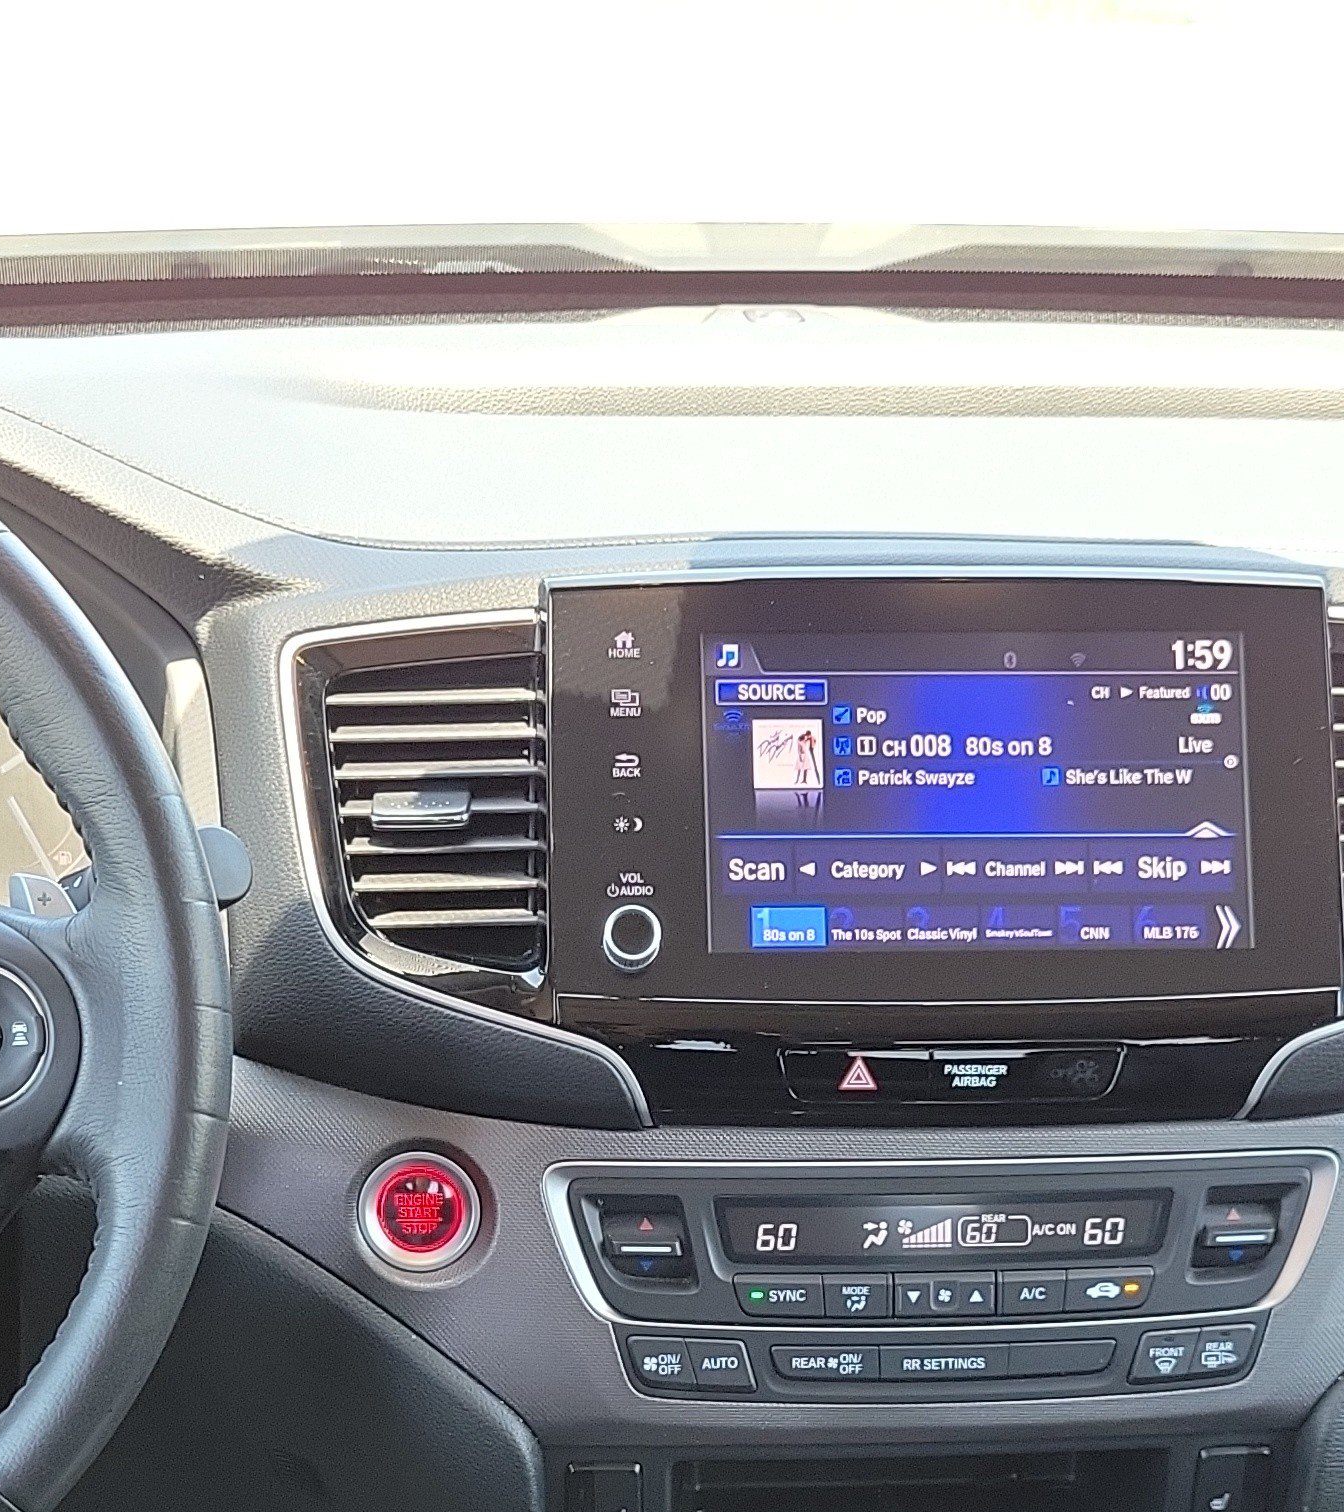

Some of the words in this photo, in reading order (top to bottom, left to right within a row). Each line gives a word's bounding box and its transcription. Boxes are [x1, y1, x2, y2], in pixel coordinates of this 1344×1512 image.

[608, 648, 641, 659] HOME
[1171, 639, 1233, 670] 1:59
[737, 683, 805, 701] SOURCE
[1091, 686, 1110, 699] CH
[1139, 686, 1191, 699] Featured
[610, 707, 641, 717] MENU
[856, 707, 887, 724] Pop
[882, 740, 906, 756] CH
[910, 735, 952, 757] 008
[965, 736, 1004, 756] 80s
[1007, 740, 1034, 756] on
[1038, 736, 1053, 756] 8
[1178, 736, 1214, 754] Live
[612, 768, 641, 778] BACK
[858, 769, 912, 785] Patrick
[915, 770, 975, 788] Swayze
[1065, 768, 1107, 785] She's
[1109, 768, 1143, 785] Like
[1144, 768, 1174, 785] The
[1175, 769, 1193, 785] W
[728, 858, 785, 881] Scan
[831, 861, 906, 880] Category
[984, 861, 1046, 877] Channel
[1137, 856, 1188, 881] Skip
[619, 873, 644, 883] VOL
[620, 885, 653, 896] AUDIO
[763, 929, 787, 942] 80s
[788, 931, 804, 942] on
[806, 929, 816, 942] 8
[831, 929, 853, 940] The
[854, 929, 875, 940] 10s
[876, 929, 902, 943] Spot
[907, 928, 948, 940] Classic
[949, 927, 978, 943] Vinyl
[1080, 927, 1110, 939] CNN
[1144, 927, 1173, 940] MLB
[1174, 927, 1199, 939] 176
[944, 1064, 1008, 1075] PASSENGER
[952, 1076, 997, 1087] AIRBAG
[394, 1193, 444, 1206] ENGINE
[398, 1207, 441, 1218] START
[981, 1214, 1006, 1223] REAR
[401, 1222, 438, 1234] STOP
[966, 1223, 997, 1244] 60
[1032, 1224, 1055, 1236] A/C
[1057, 1223, 1076, 1236] ON
[1083, 1217, 1126, 1246] 60
[756, 1223, 798, 1251] 60
[768, 1288, 806, 1302] SYNC
[841, 1286, 871, 1296] MODE
[1019, 1287, 1047, 1300] A/C
[1149, 1346, 1185, 1358] FRONT
[1205, 1341, 1234, 1351] REAR
[658, 1354, 681, 1365] ON/
[702, 1357, 738, 1370] AUTO
[792, 1357, 825, 1370] REAR
[839, 1353, 862, 1364] ON/
[903, 1358, 923, 1371] RR
[924, 1357, 986, 1370] SETTINGS
[658, 1364, 682, 1375] OFF
[839, 1363, 864, 1375] OFF
